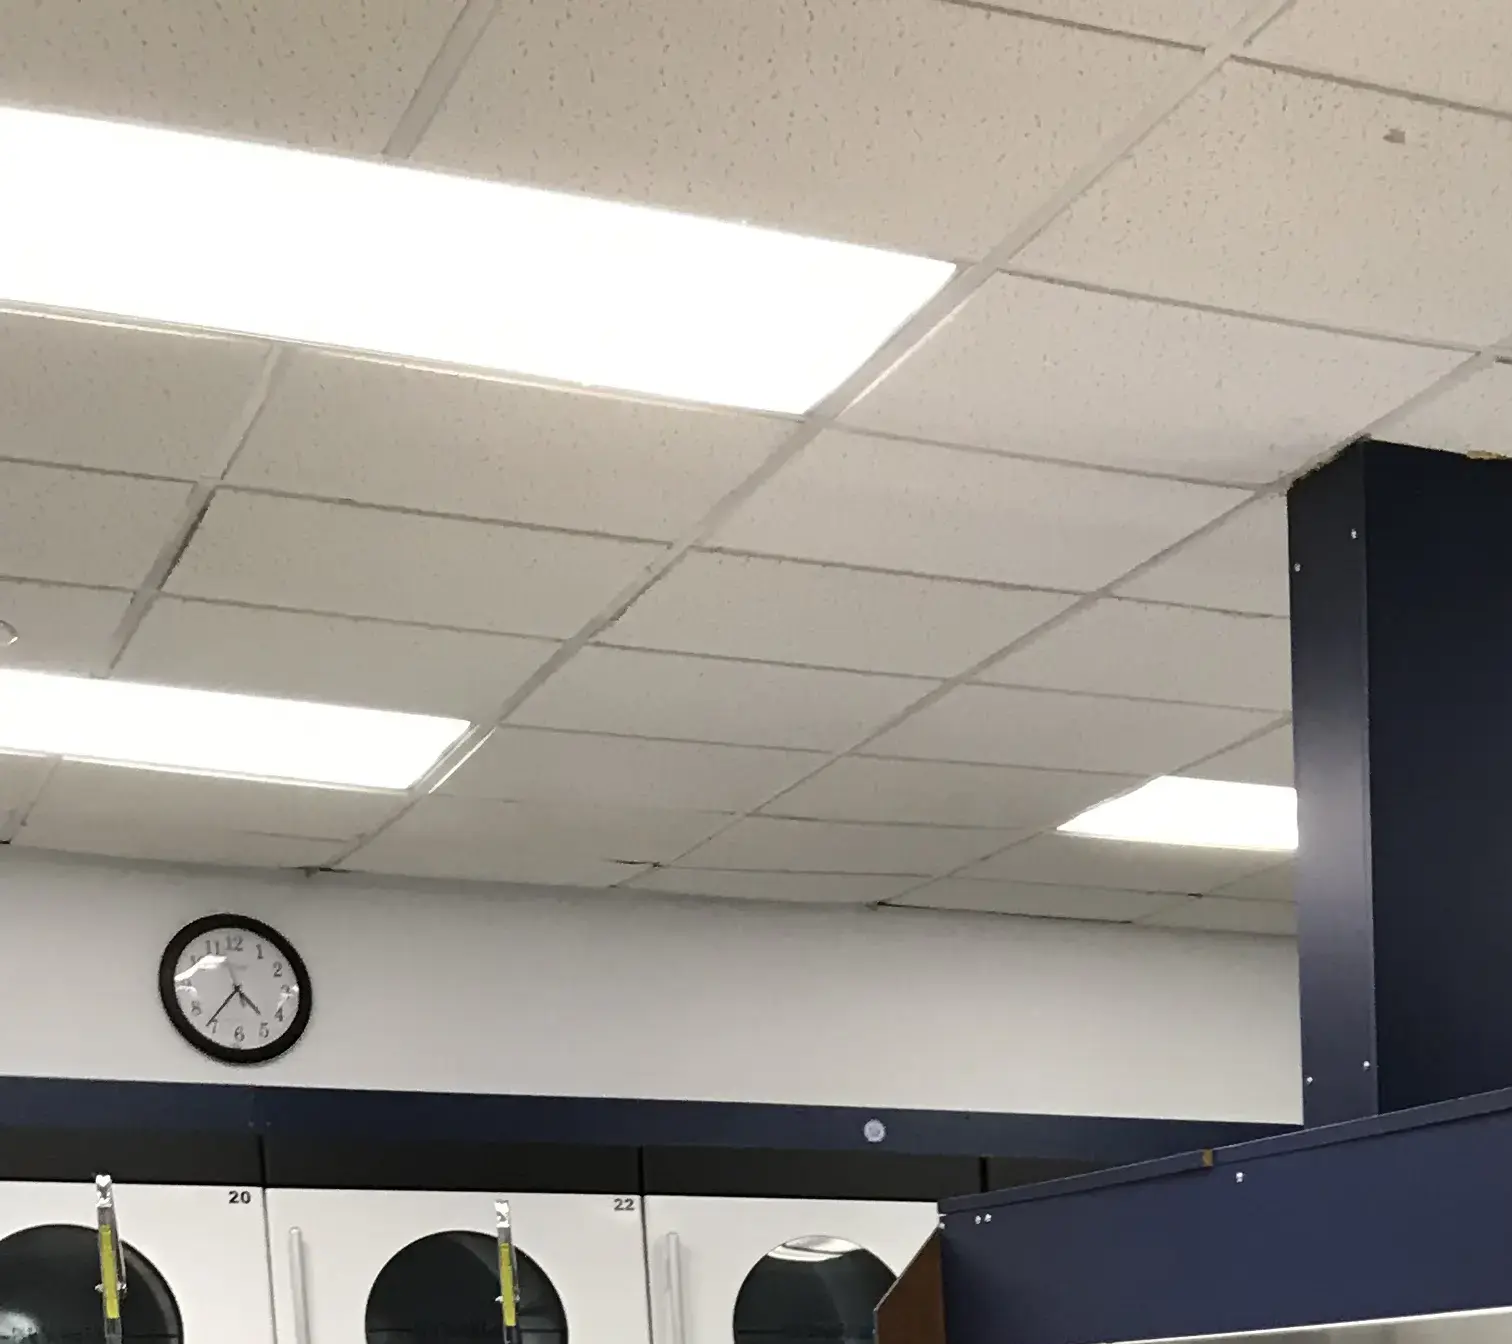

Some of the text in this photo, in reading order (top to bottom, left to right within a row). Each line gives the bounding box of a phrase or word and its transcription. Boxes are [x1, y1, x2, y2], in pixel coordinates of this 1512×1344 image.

[226, 936, 243, 951] 12
[256, 944, 263, 959] 1
[273, 962, 283, 977] 2
[191, 1001, 202, 1016] 8
[274, 1006, 284, 1022] 4
[234, 1026, 245, 1042] 6
[259, 1023, 269, 1038] 5
[228, 1190, 251, 1204] 20
[614, 1198, 634, 1211] 22
